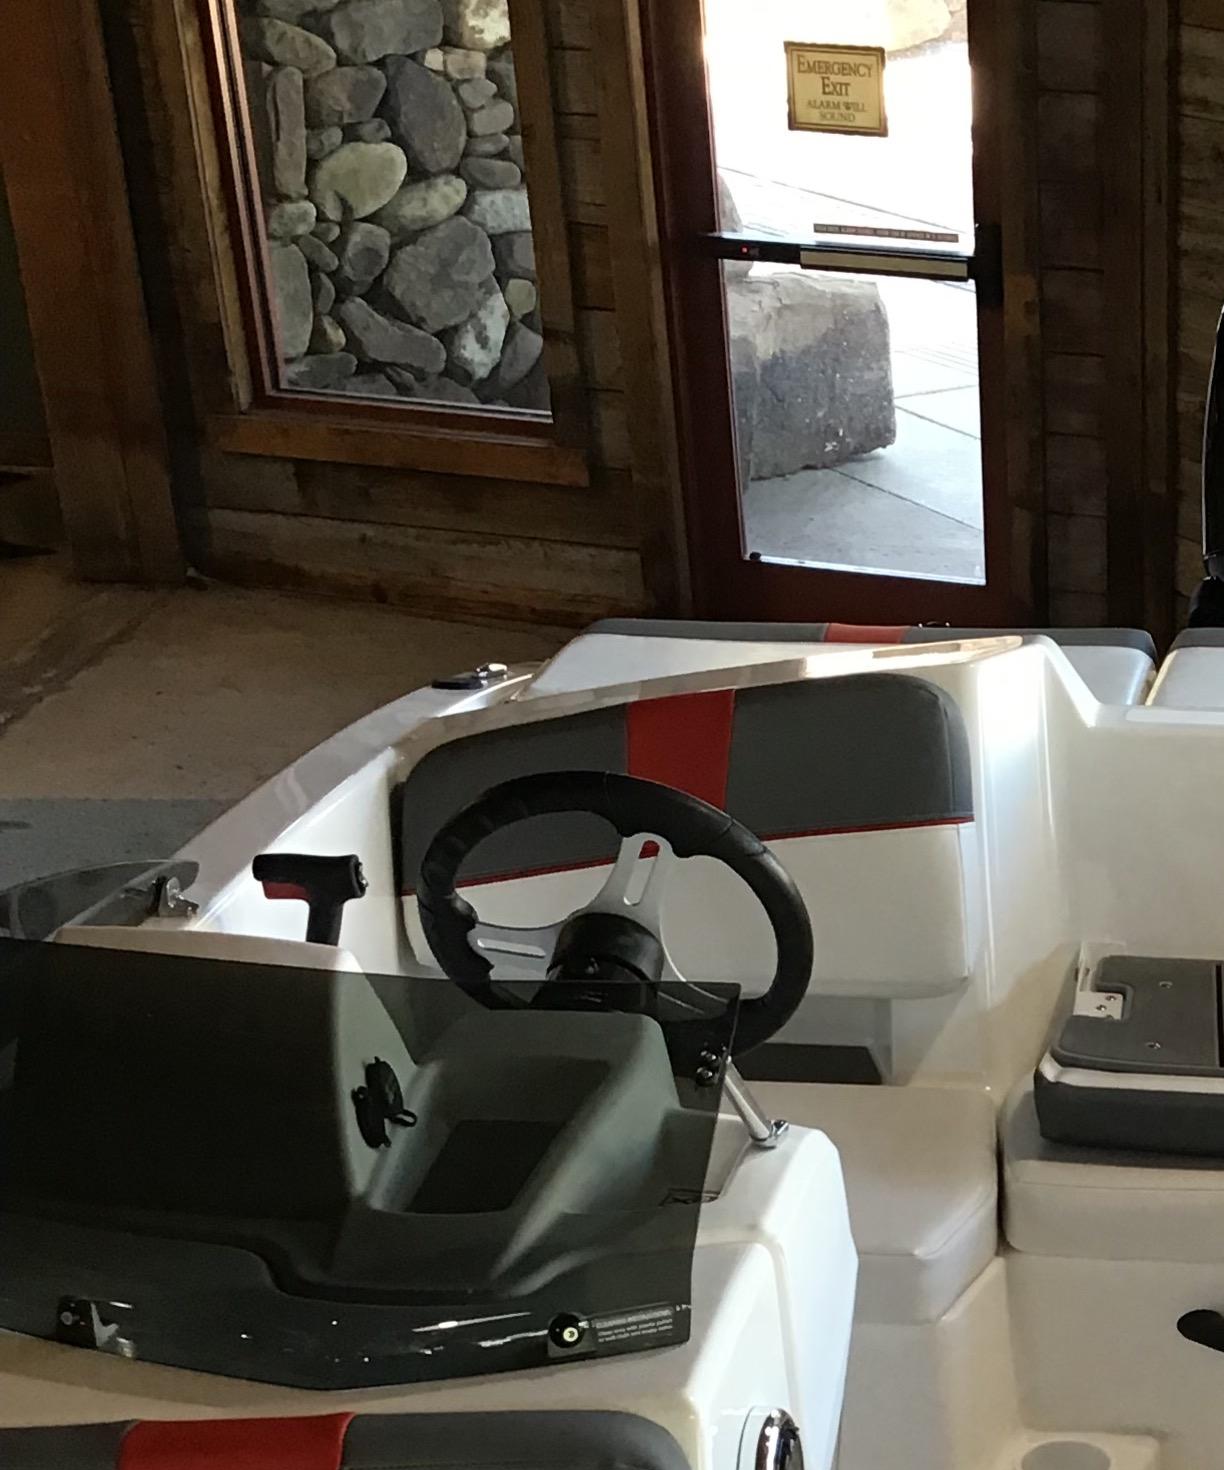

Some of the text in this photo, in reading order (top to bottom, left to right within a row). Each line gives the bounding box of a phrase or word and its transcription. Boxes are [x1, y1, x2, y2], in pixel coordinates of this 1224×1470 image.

[796, 54, 873, 78] EMERGENCY
[821, 76, 850, 97] EXIT
[807, 99, 866, 113] ALARM WILL
[818, 111, 856, 123] SOUND
